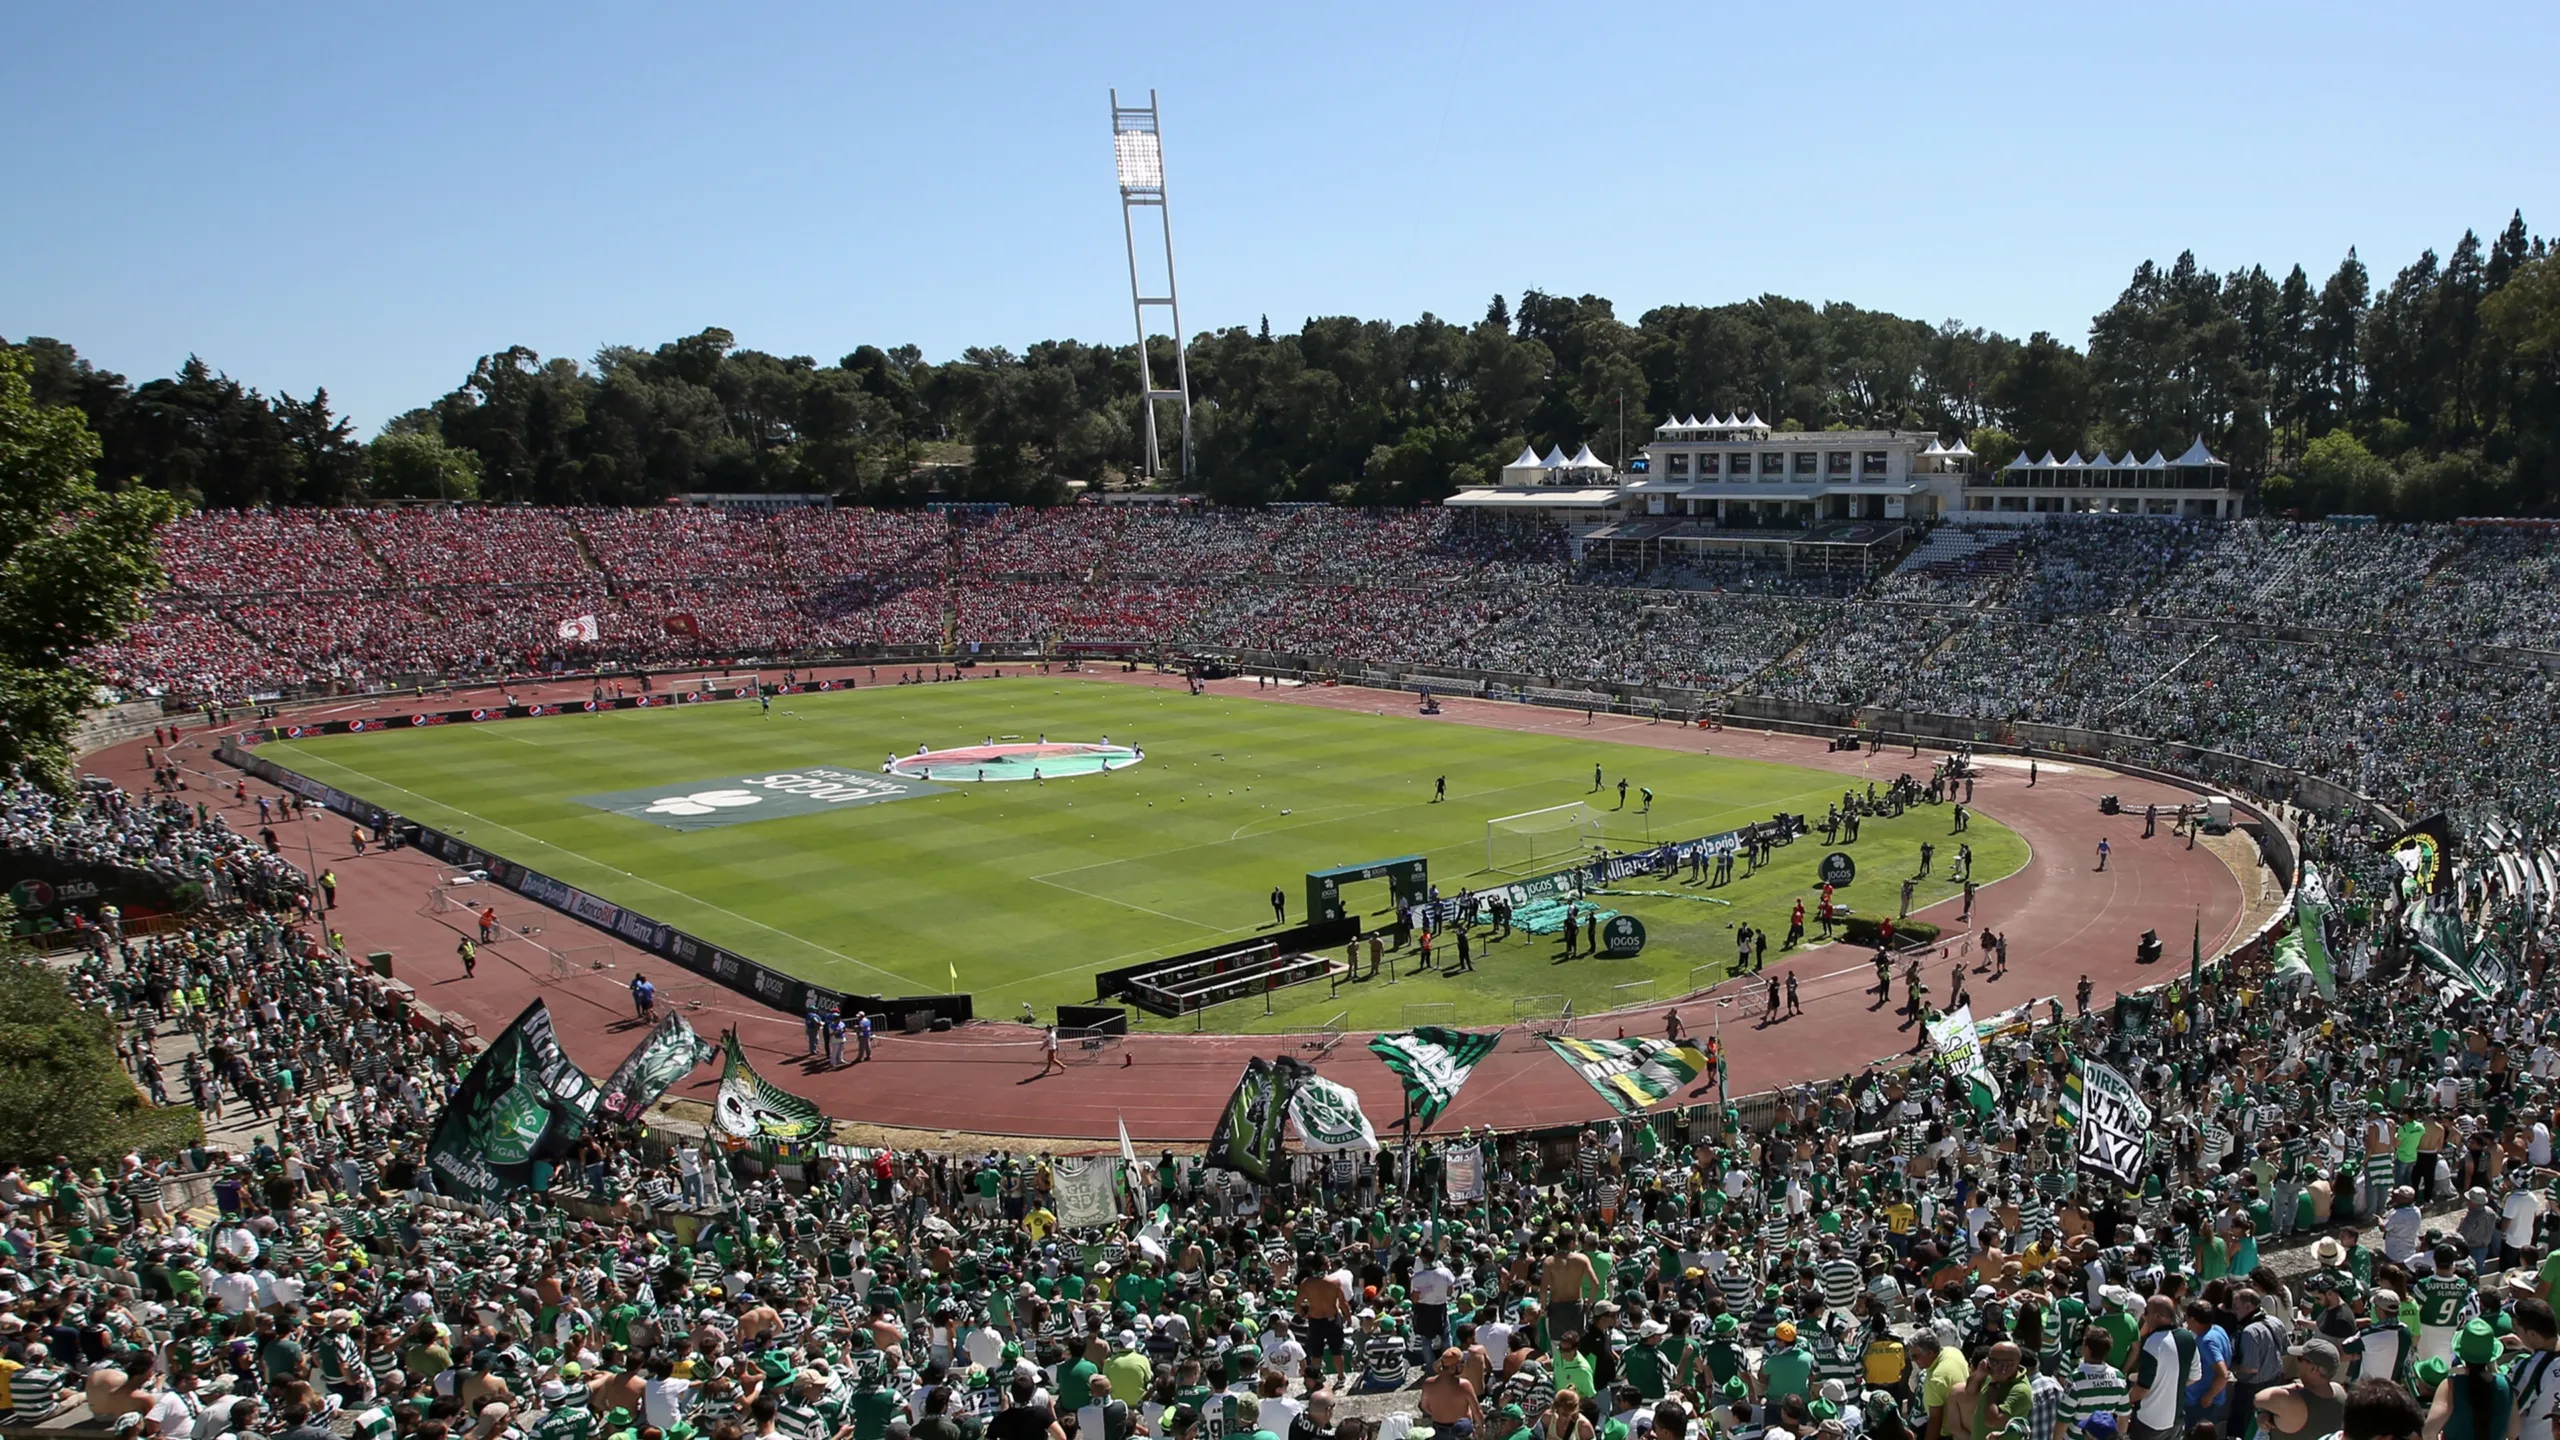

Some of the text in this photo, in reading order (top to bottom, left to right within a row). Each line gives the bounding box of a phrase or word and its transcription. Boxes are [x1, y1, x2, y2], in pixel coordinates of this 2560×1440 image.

[742, 774, 907, 802] JOGOS
[1828, 869, 1851, 881] JOGOS
[1526, 880, 1552, 898] JOGOS
[578, 897, 617, 929] BancoBIC
[617, 911, 653, 943] Allianz
[1610, 936, 1641, 949] JOGOS
[722, 958, 740, 974] JOGOS
[765, 976, 784, 994] JOGOS
[816, 996, 841, 1012] JOGOS
[1635, 1176, 1645, 1188] 77
[1895, 1217, 1908, 1230] 17
[2426, 1283, 2450, 1291] SUPER
[2436, 1299, 2458, 1325] 9
[666, 1319, 681, 1334] 18
[2066, 1317, 2077, 1340] 7
[1373, 1350, 1400, 1371] 76
[966, 1391, 989, 1412] 12
